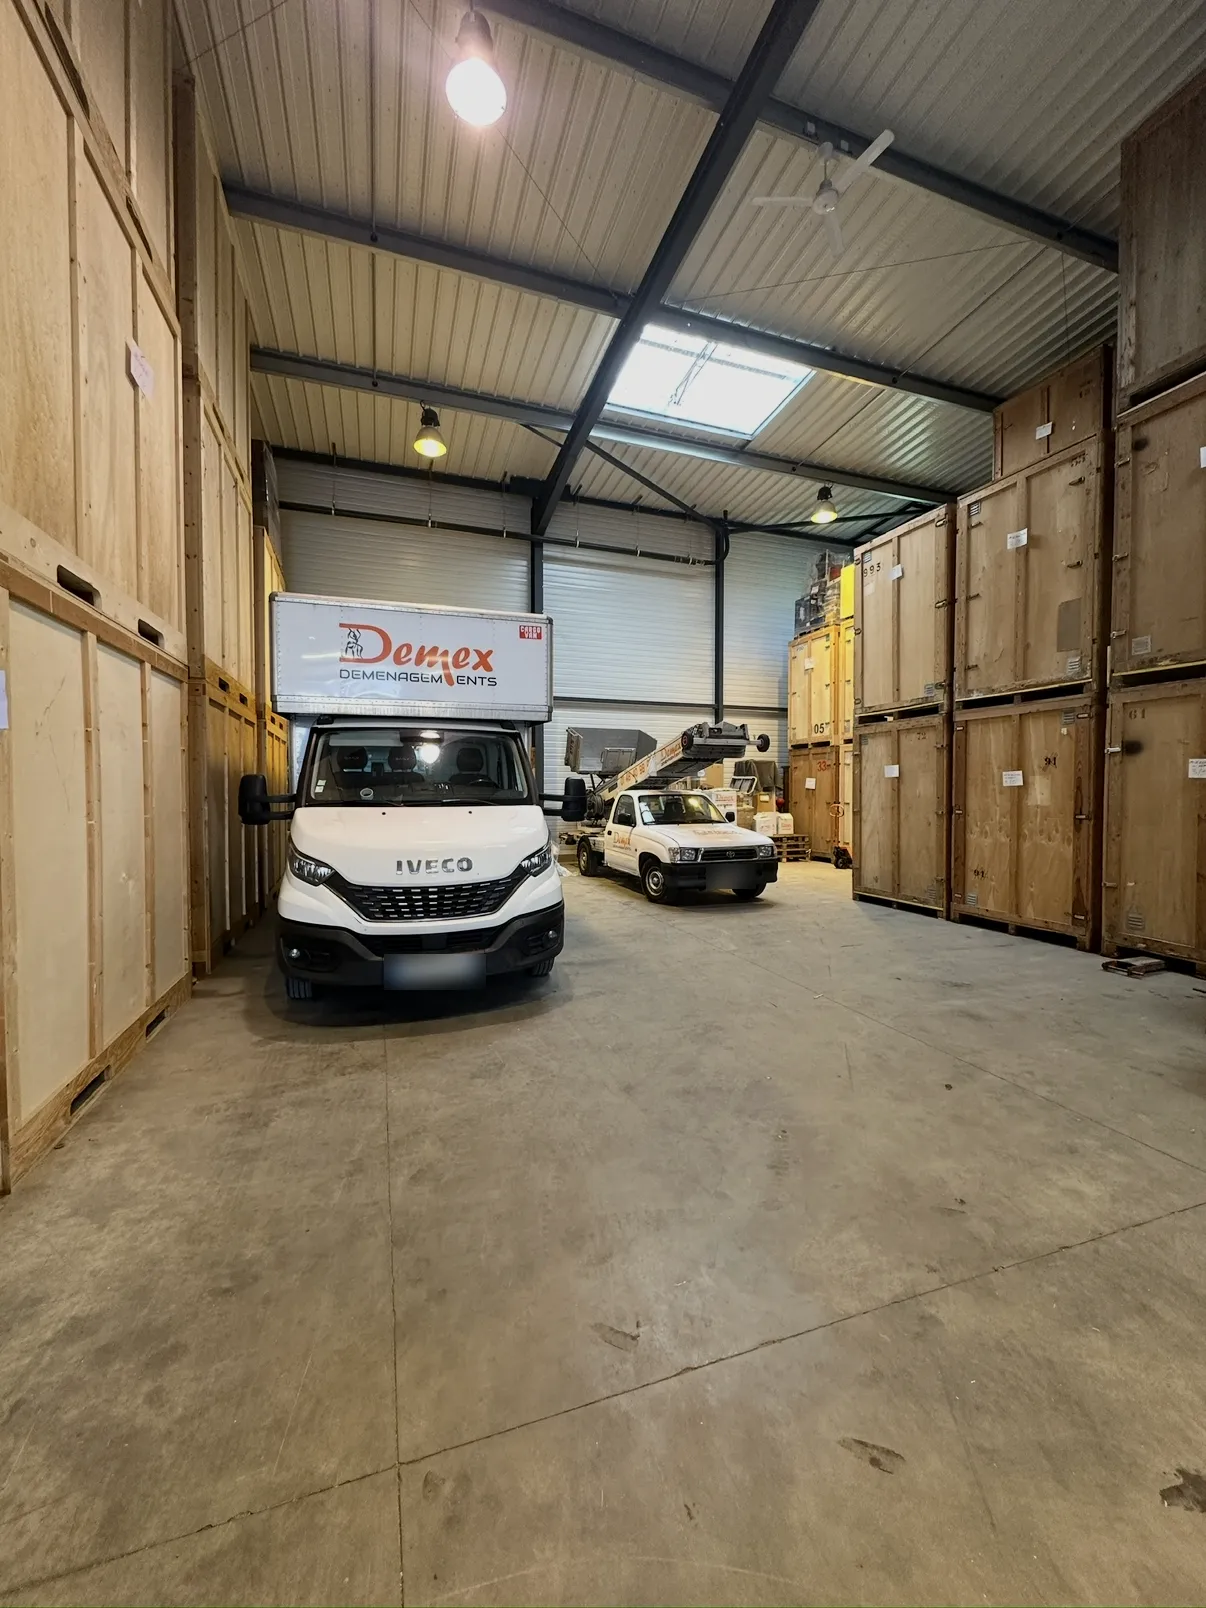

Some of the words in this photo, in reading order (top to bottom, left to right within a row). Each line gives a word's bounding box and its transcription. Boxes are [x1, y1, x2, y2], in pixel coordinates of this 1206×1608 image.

[524, 631, 538, 639] VAN
[339, 623, 493, 686] Demex
[814, 723, 825, 734] 05
[395, 857, 473, 875] IVECO
